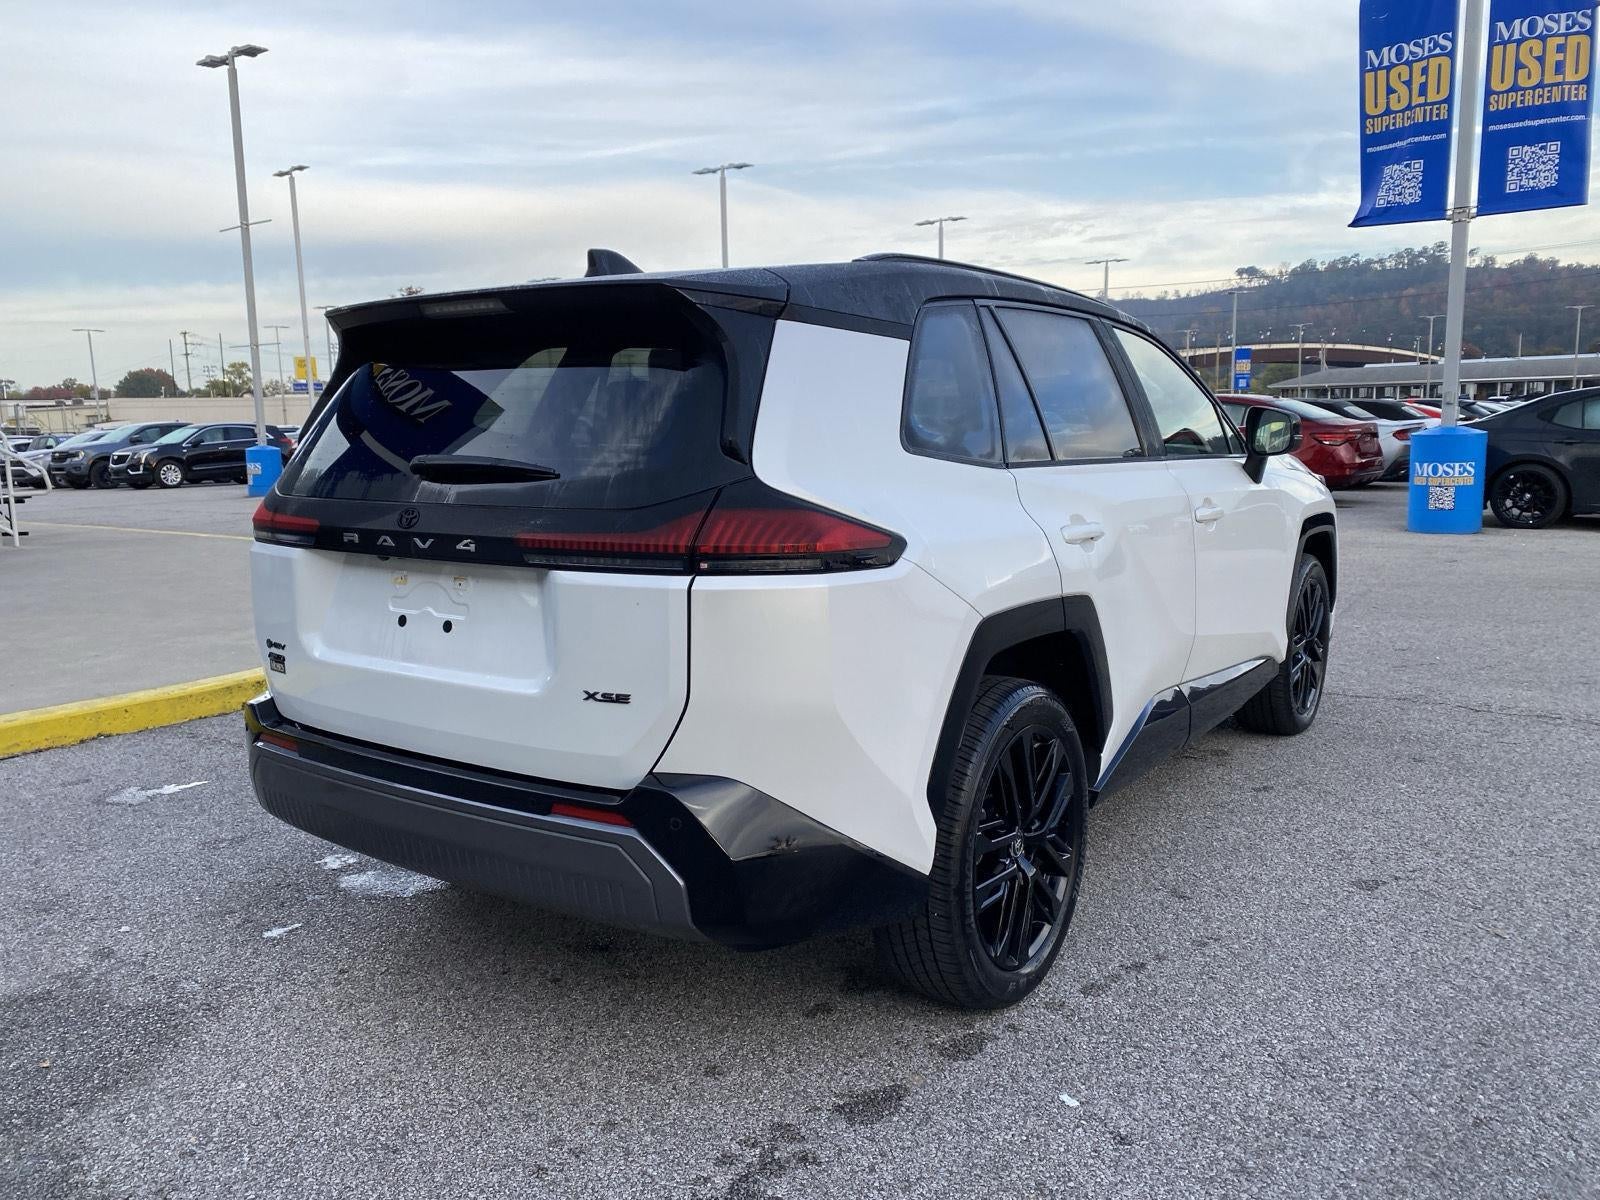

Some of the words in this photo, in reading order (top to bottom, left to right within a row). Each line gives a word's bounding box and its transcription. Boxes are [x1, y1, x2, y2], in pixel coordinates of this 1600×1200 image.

[1494, 9, 1592, 43] MOSES
[1365, 32, 1453, 70] MOSES
[1490, 34, 1591, 92] USED
[1364, 56, 1452, 116] USED
[1488, 84, 1588, 112] SUPERCENTER
[1365, 104, 1448, 135] SUPERCENTER
[1488, 115, 1586, 132] mosesusedsupercenter.com
[1415, 461, 1475, 477] MOSES
[343, 532, 476, 553] RAV4
[582, 690, 632, 704] XSE
